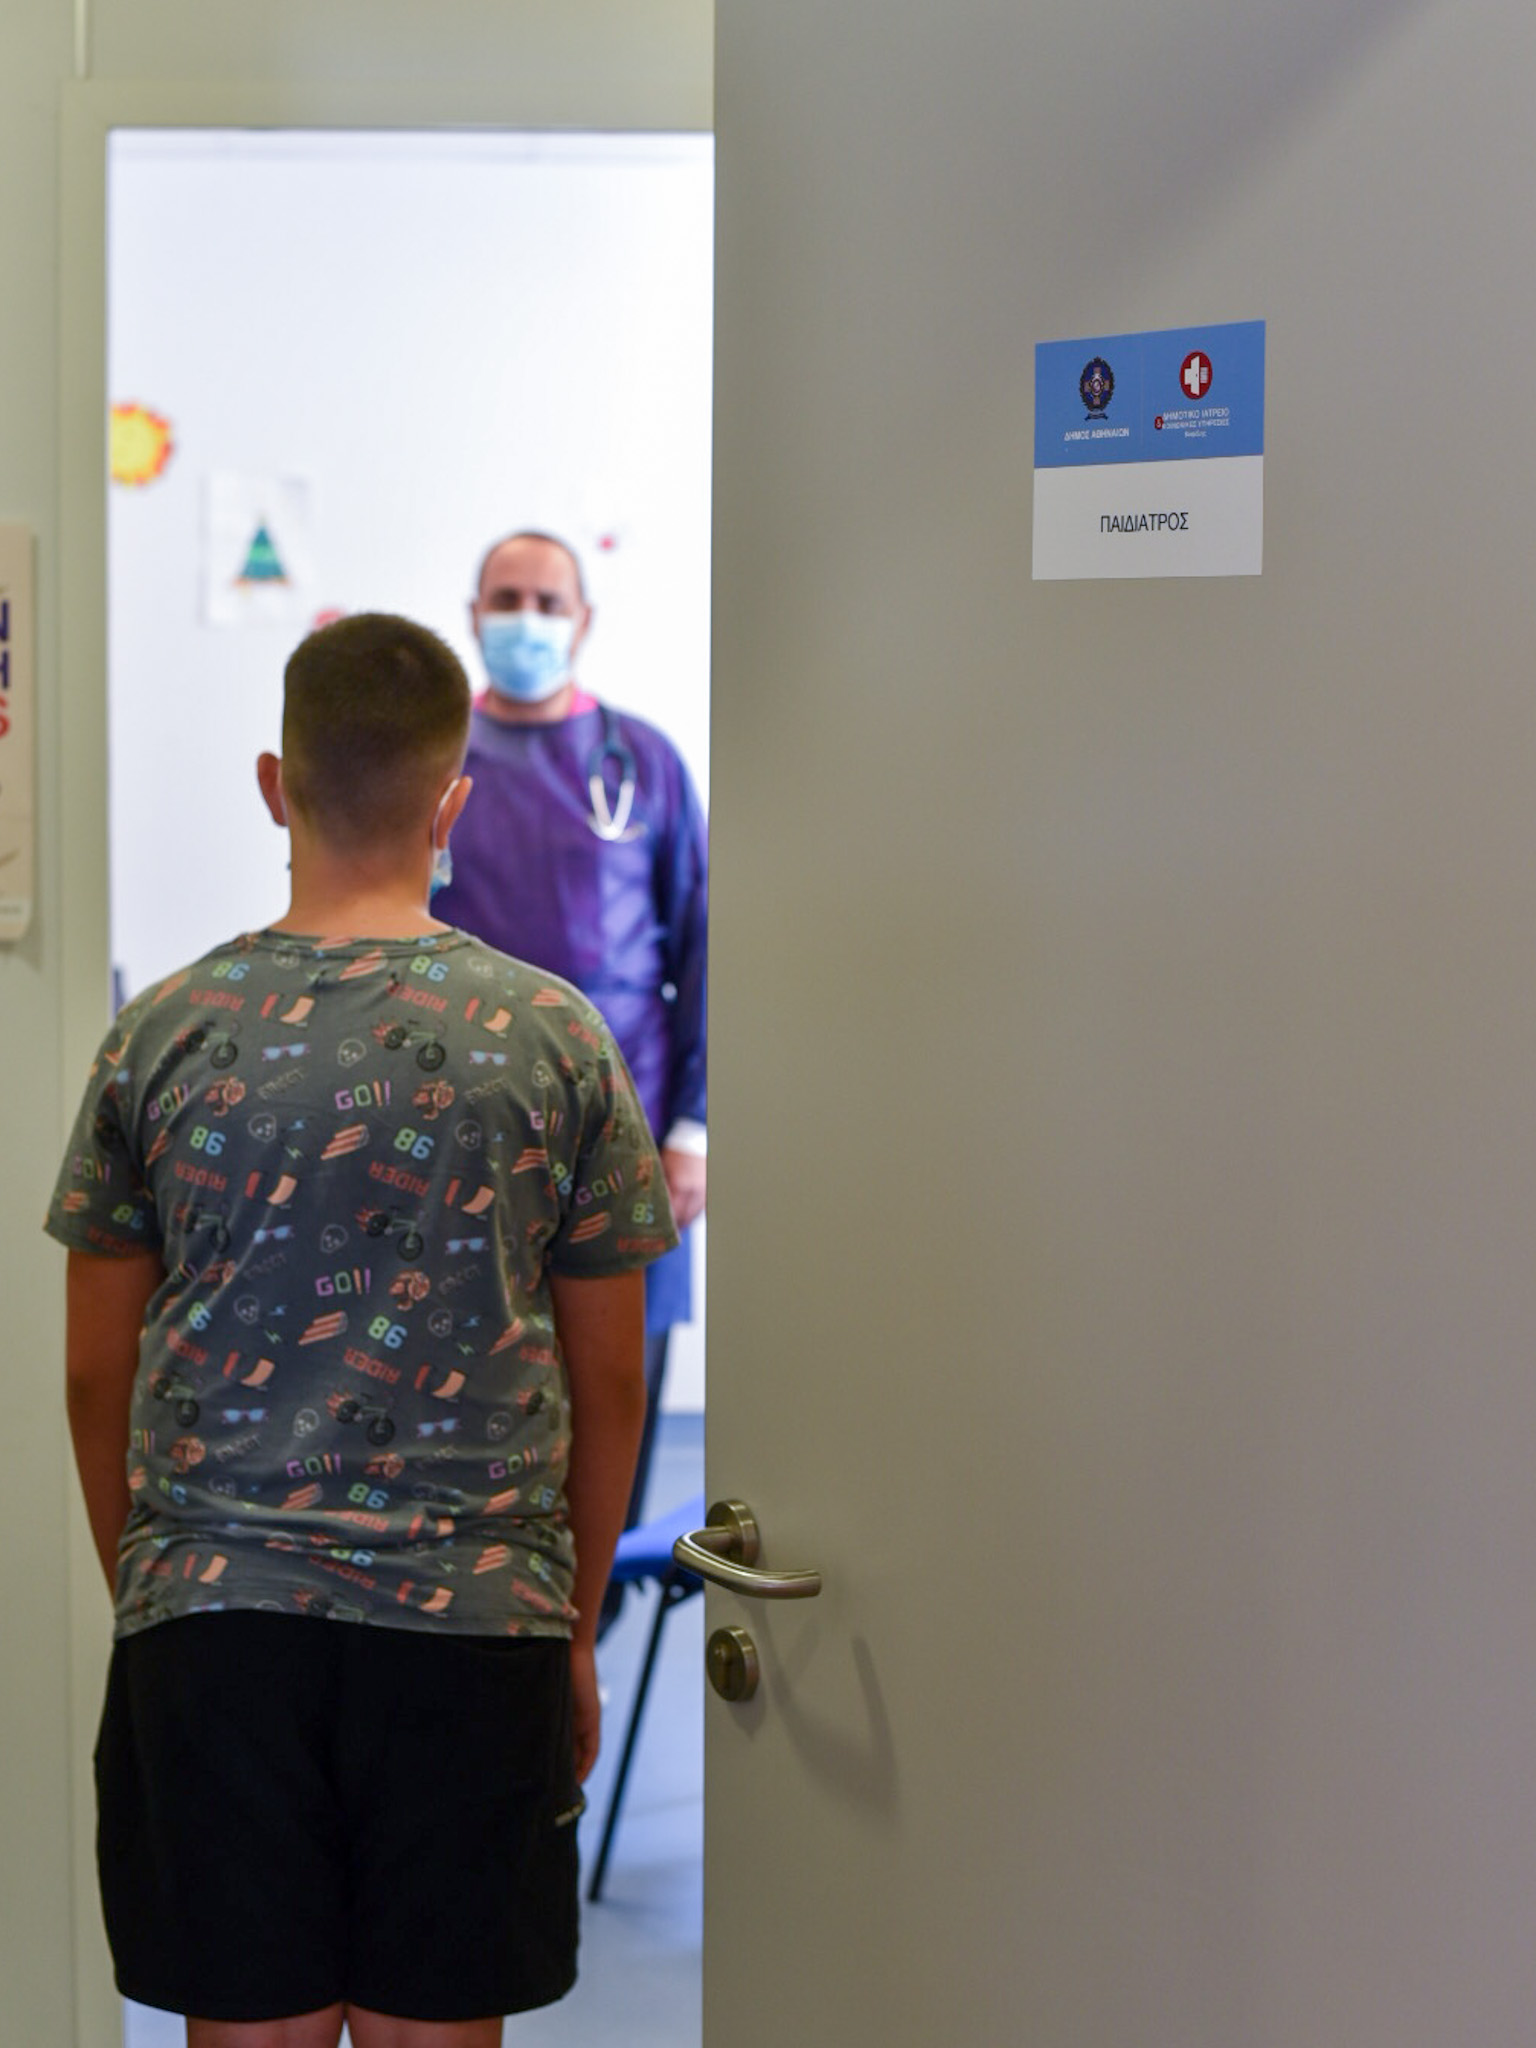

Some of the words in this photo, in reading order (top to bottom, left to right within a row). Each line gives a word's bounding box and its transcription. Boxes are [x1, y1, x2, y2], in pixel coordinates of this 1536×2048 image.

[1064, 430, 1090, 441] ΔΗΜΟΣ
[1091, 427, 1130, 439] ΑΘΗΝΑΙΩΝ
[1100, 512, 1190, 533] ΠΑΙΔΙΑΤΡΟΣ
[210, 961, 251, 981] 86
[410, 955, 449, 982] 86
[334, 1078, 391, 1111] GO!!
[189, 1125, 226, 1156] 86
[393, 1127, 434, 1160] 86
[315, 1267, 371, 1296] GO!!
[368, 1315, 408, 1349] 86
[286, 1453, 341, 1478] GO!!
[348, 1482, 389, 1509] 86
